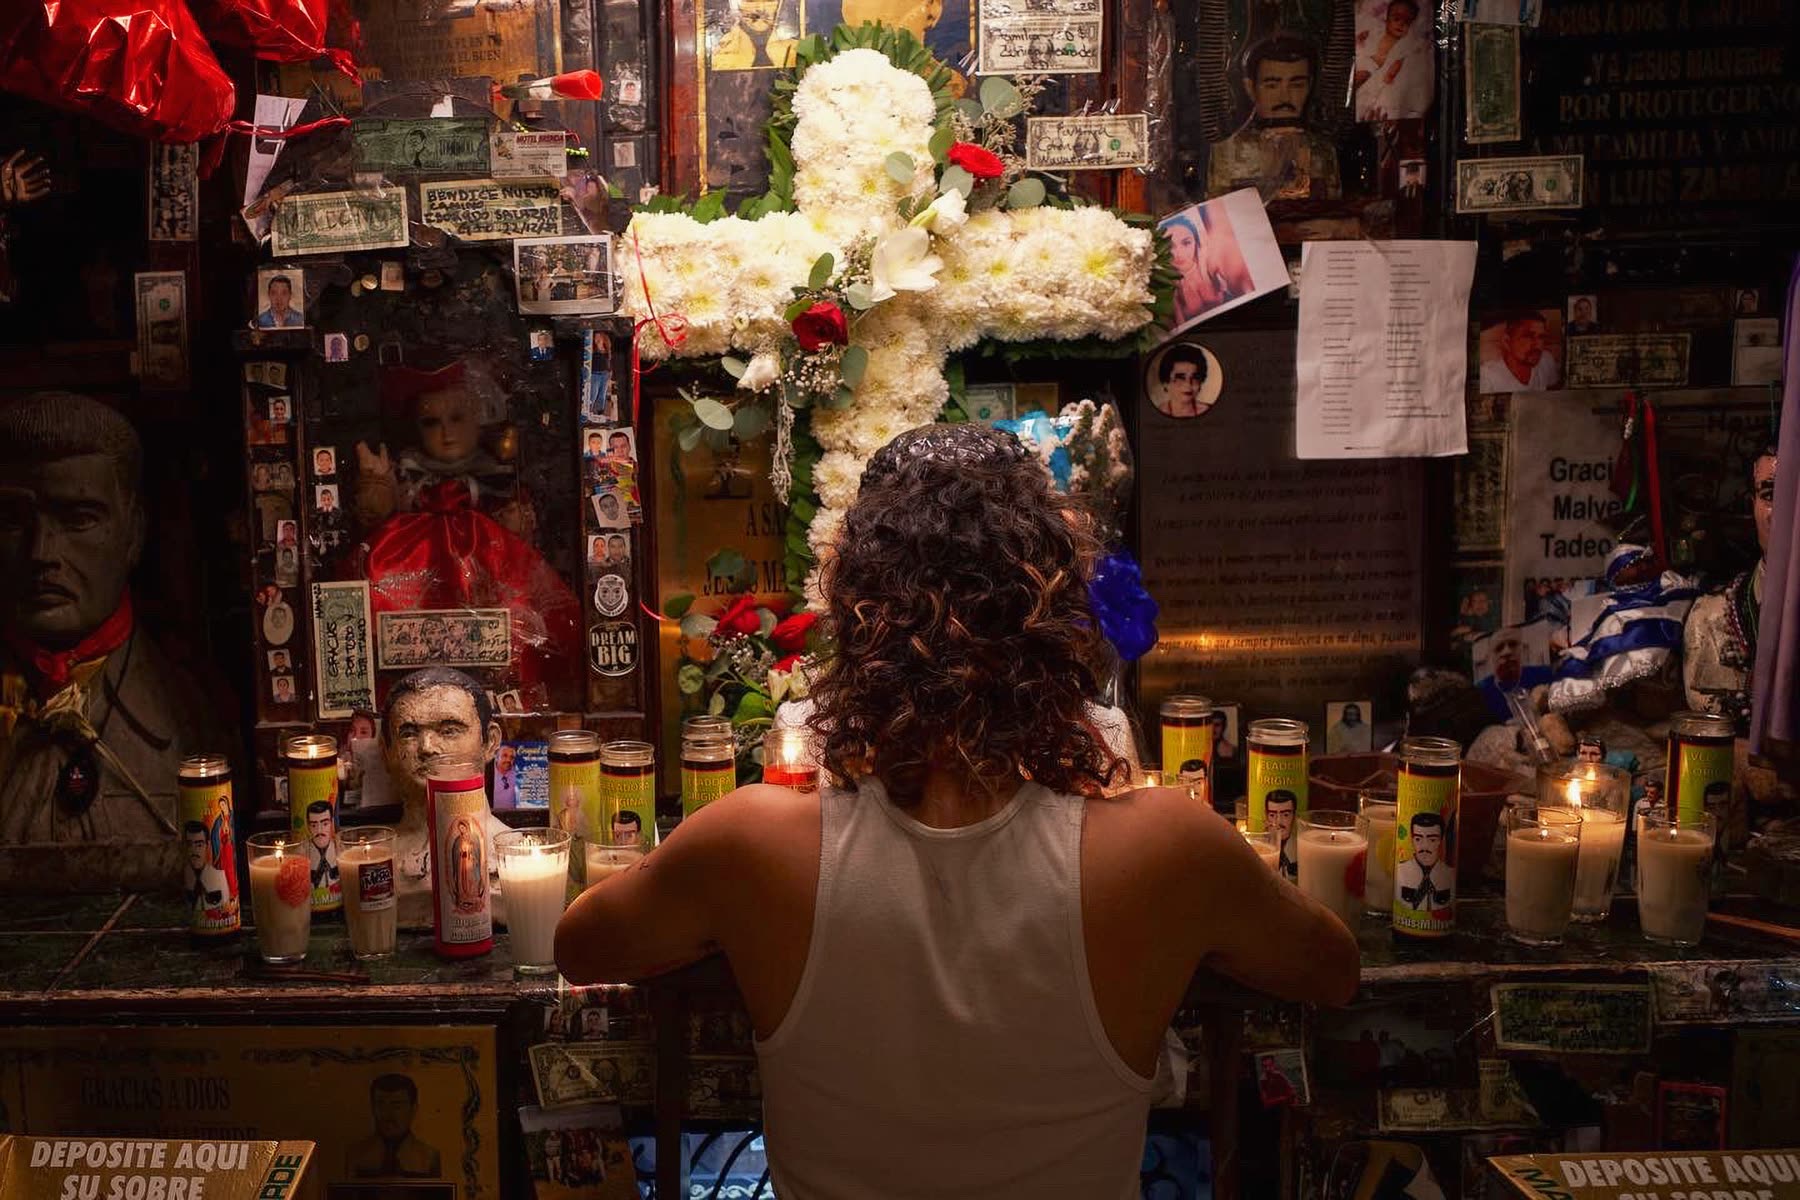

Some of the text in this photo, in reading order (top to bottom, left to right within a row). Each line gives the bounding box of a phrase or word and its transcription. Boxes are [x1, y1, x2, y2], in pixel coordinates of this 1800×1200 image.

[427, 188, 498, 202] BENDICE
[591, 630, 636, 646] DREAM
[597, 644, 632, 665] BIG
[30, 1140, 250, 1172] DEPOSITE AQUI
[1559, 1154, 1800, 1188] DEPOSITE AQUI
[60, 1174, 205, 1200] SU SOBRE
